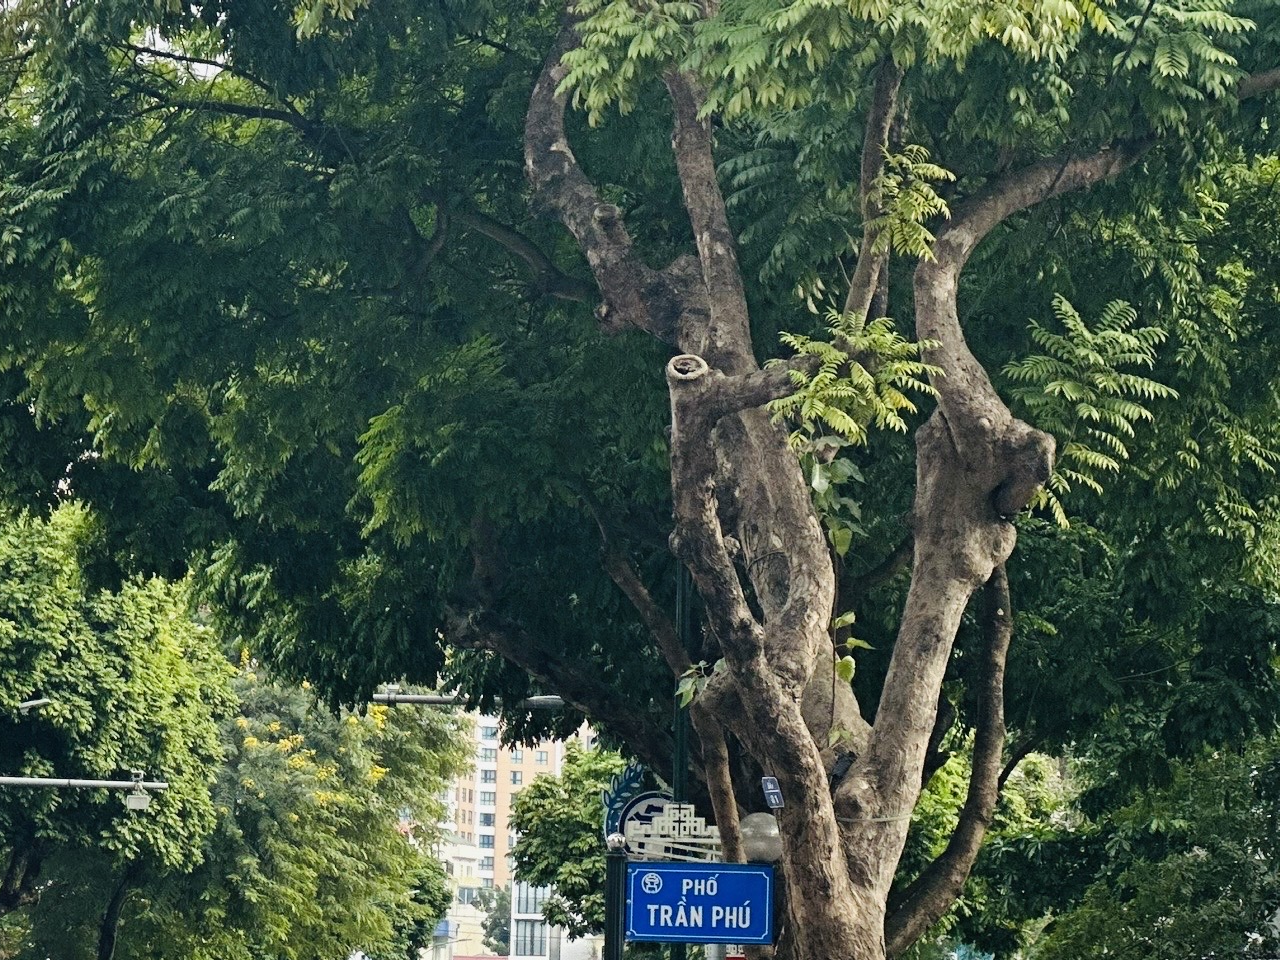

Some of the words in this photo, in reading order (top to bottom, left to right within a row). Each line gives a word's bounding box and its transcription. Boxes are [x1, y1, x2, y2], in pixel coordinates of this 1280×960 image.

[681, 873, 720, 896] PHỐ
[646, 895, 703, 928] TRẦN
[711, 900, 751, 929] PHÚ
